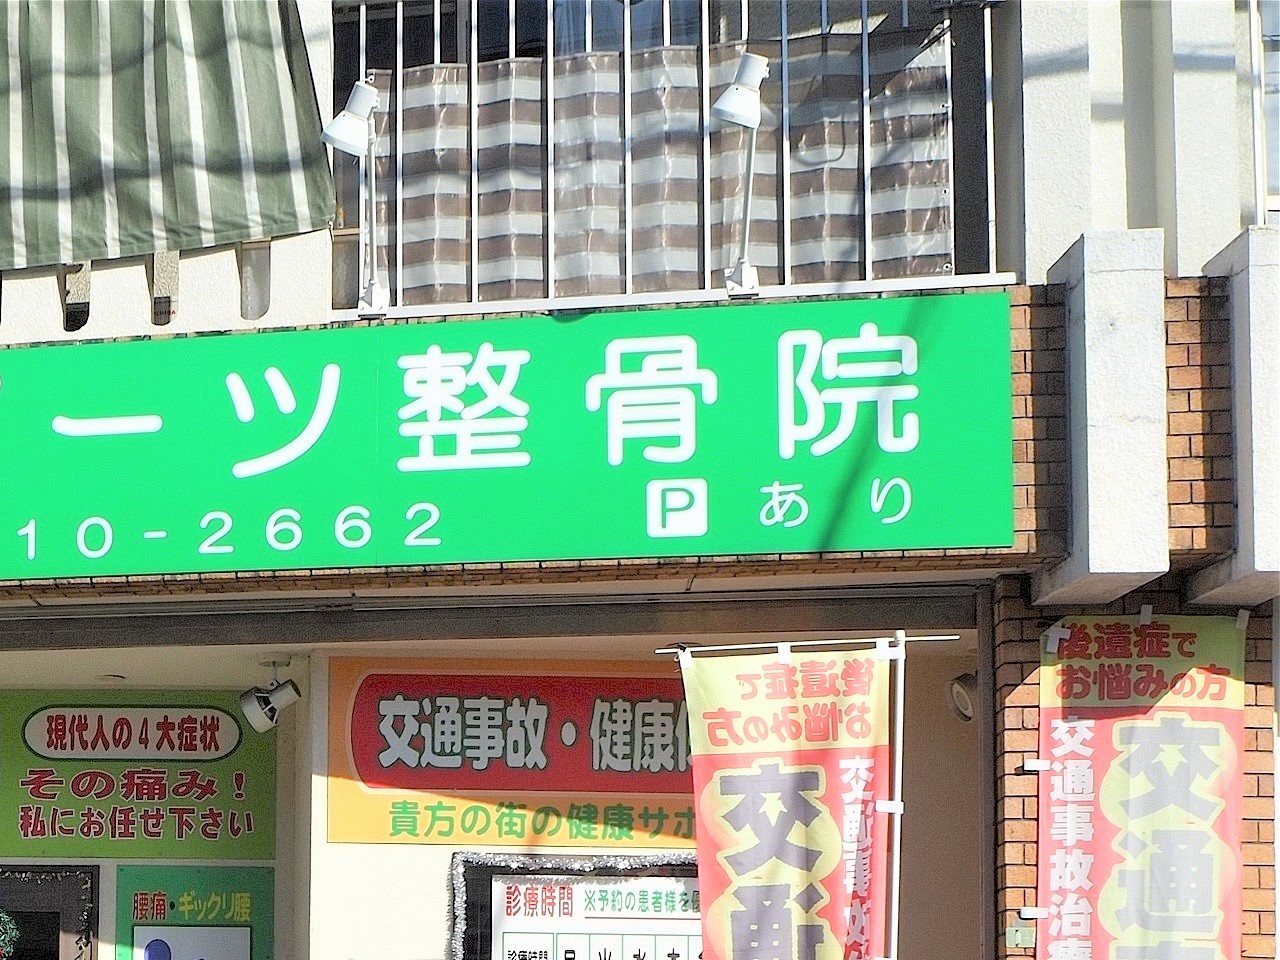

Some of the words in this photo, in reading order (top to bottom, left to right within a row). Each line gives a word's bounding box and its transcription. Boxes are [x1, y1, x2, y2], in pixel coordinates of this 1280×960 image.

[758, 477, 914, 528] あり
[1057, 621, 1197, 660] 後遺症で
[1056, 663, 1230, 701] お悩みの方
[19, 805, 255, 840] 私にお任せ下さい
[505, 885, 574, 918] 診療時間
